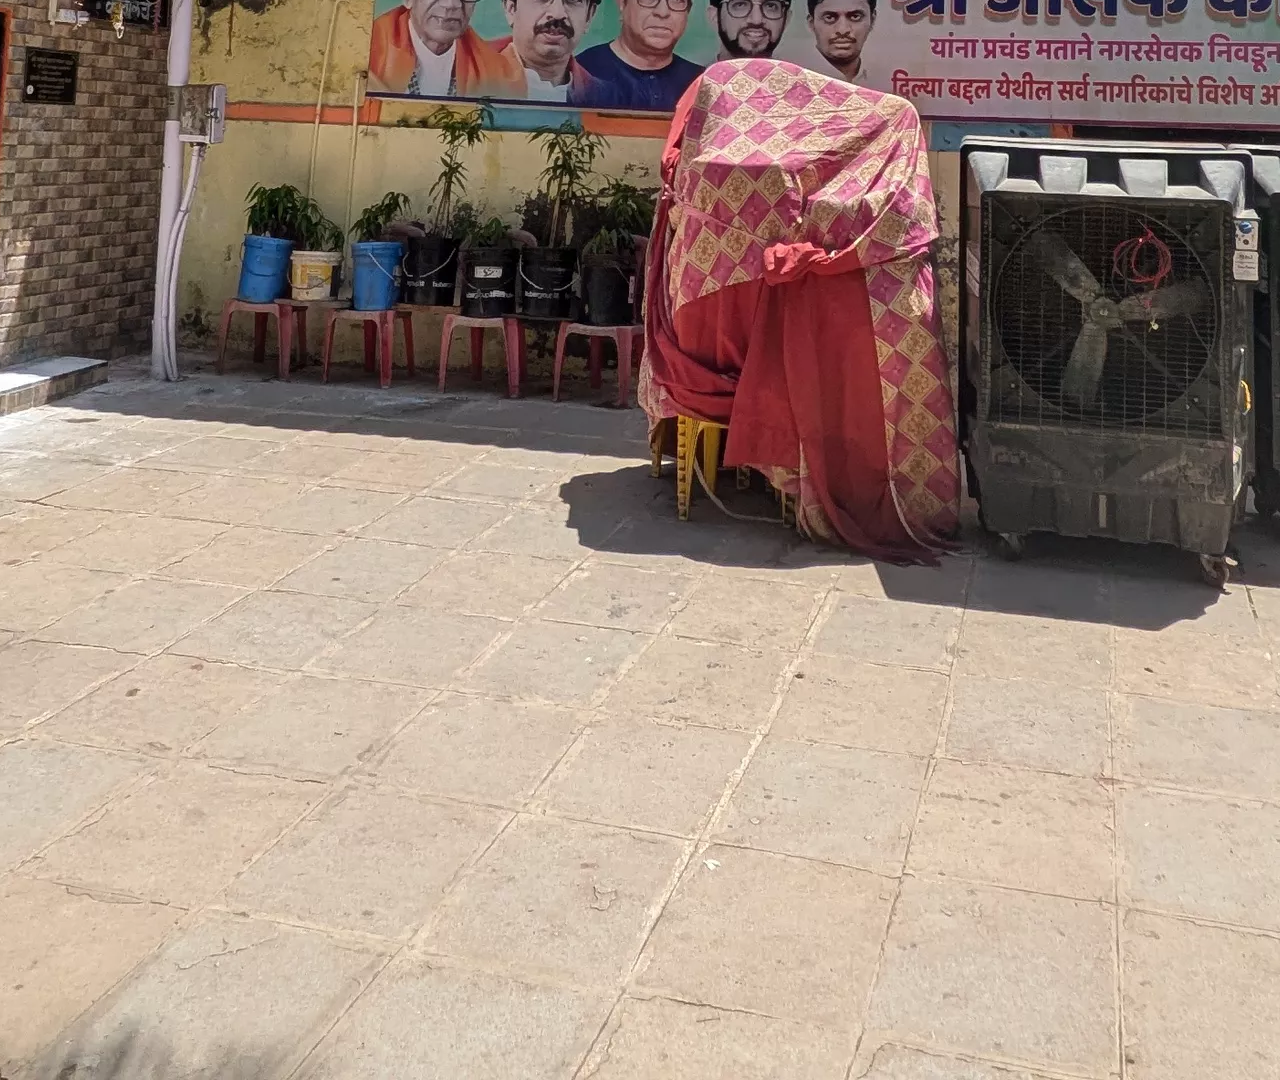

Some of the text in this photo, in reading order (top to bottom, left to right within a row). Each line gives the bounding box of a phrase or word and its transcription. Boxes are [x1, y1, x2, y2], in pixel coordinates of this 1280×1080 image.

[929, 31, 979, 59] यांना
[981, 31, 1033, 60] प्रचंड
[1035, 32, 1095, 61] मताने
[1097, 33, 1205, 63] नगरसेवक
[891, 69, 945, 100] दिल्या
[946, 77, 993, 105] बद्दल
[995, 71, 1054, 101] येथील
[1056, 72, 1090, 102] सर्व
[1092, 74, 1194, 105] नागरिकांचे
[1196, 75, 1256, 106] विशेष
